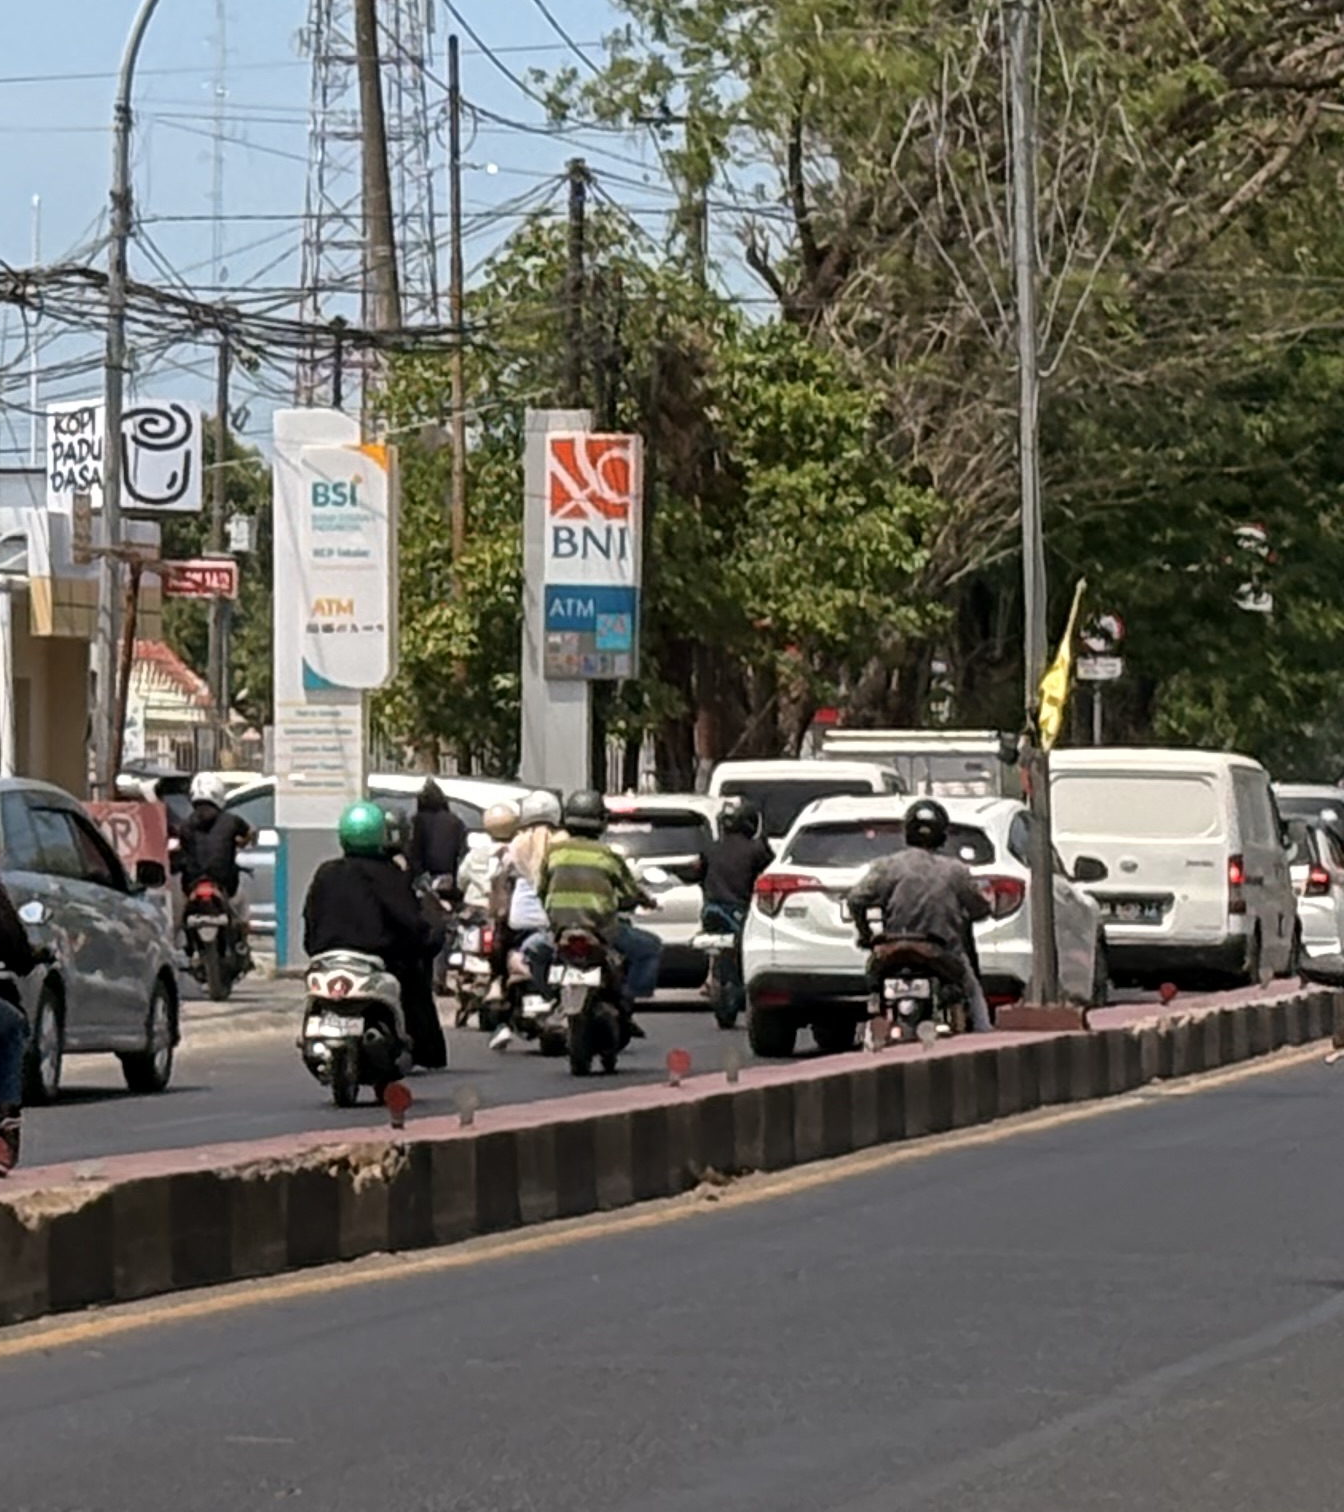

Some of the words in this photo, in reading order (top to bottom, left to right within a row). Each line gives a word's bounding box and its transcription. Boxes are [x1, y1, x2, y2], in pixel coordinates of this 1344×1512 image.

[53, 406, 97, 435] KOPI
[51, 437, 102, 469] PADU
[311, 475, 363, 508] BSI
[551, 525, 628, 560] BNI
[311, 599, 354, 616] ATM
[548, 597, 595, 617] ATM
